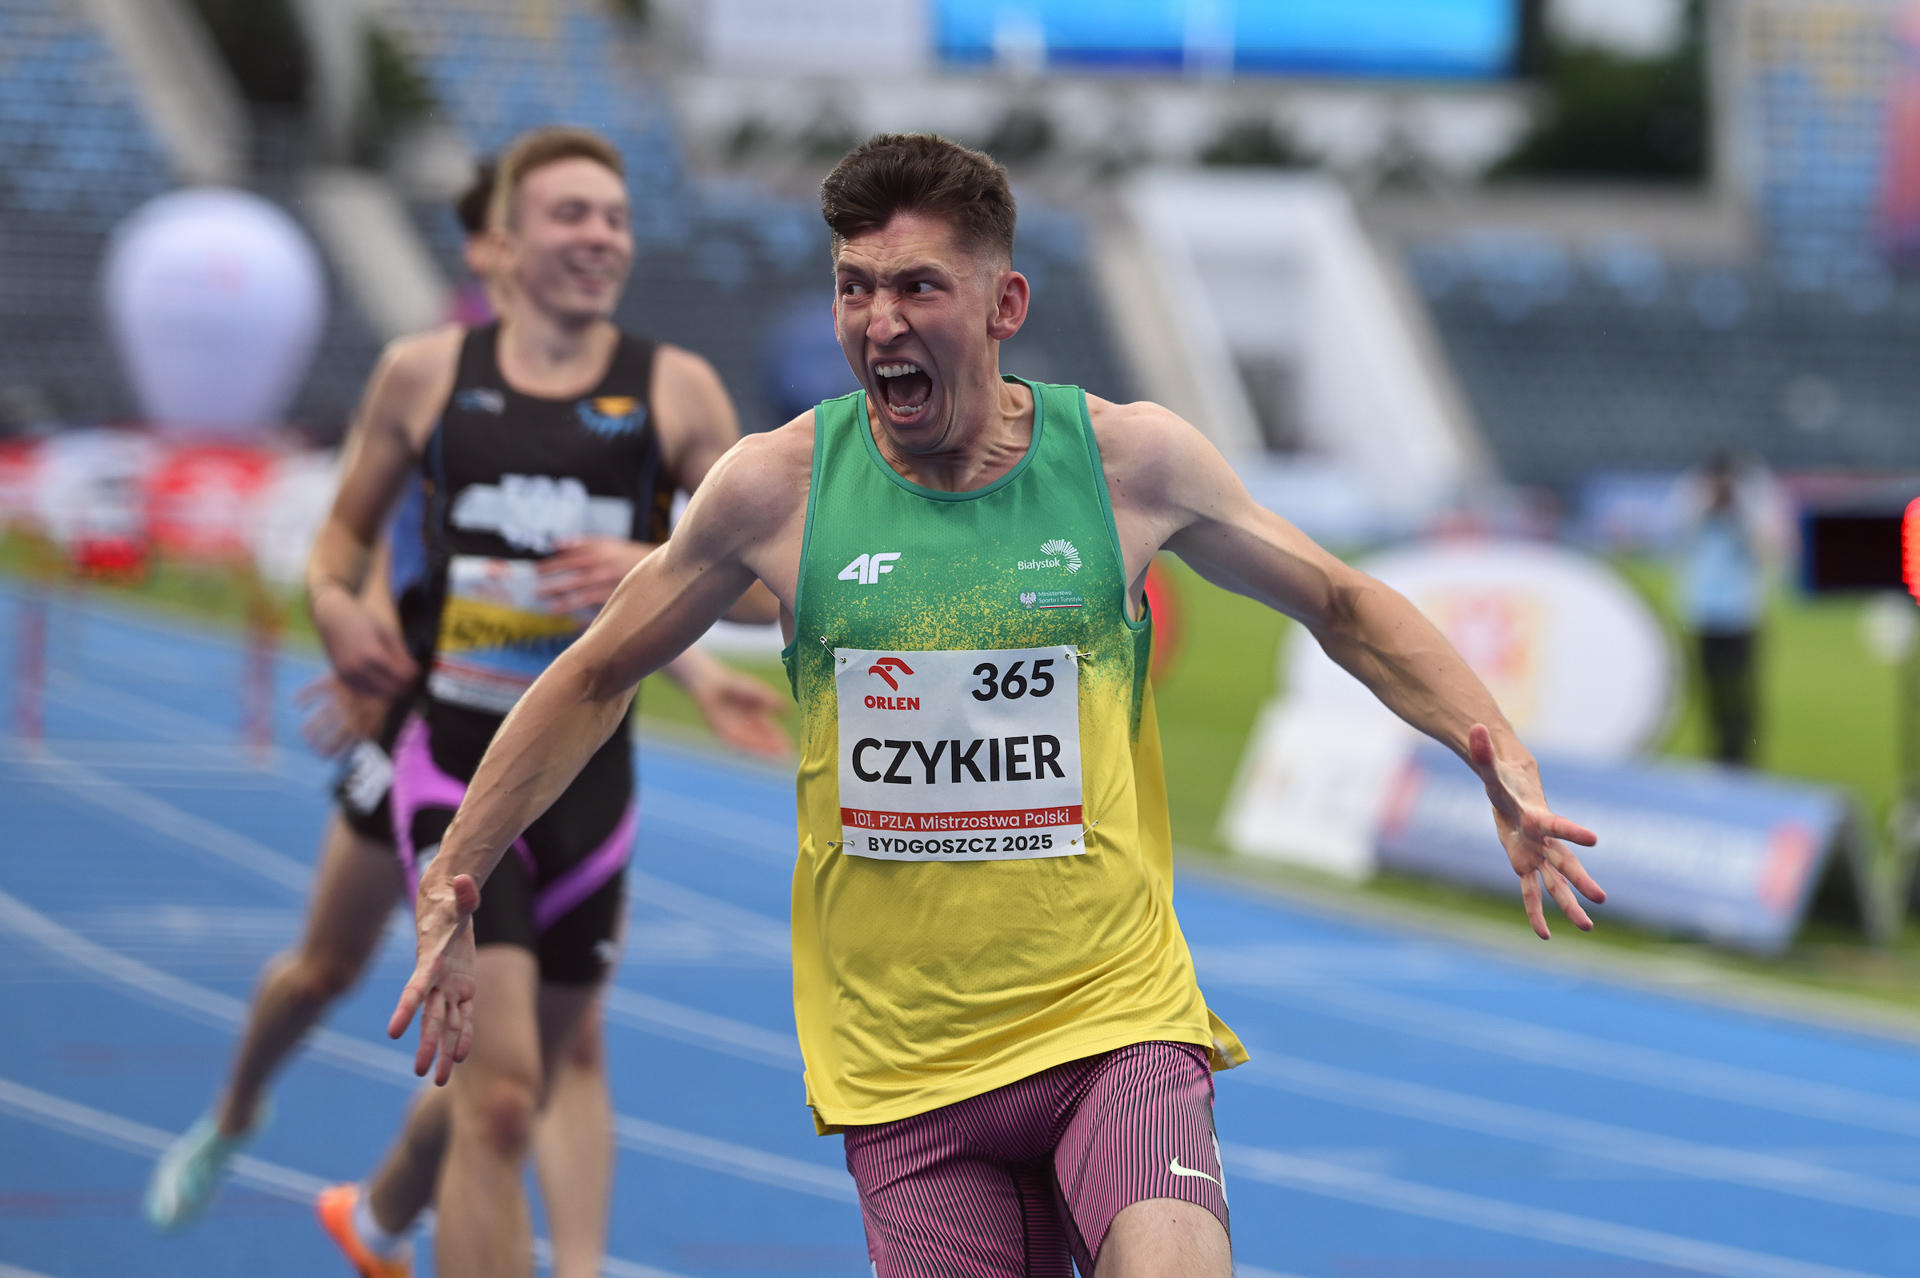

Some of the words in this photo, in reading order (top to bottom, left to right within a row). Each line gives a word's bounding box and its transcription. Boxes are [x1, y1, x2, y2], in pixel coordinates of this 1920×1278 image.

[838, 552, 902, 585] 4F
[1017, 557, 1061, 571] Białystok
[971, 659, 1055, 701] 365
[864, 695, 920, 710] ORLEN
[852, 734, 1065, 784] CZYKIER
[852, 812, 875, 828] 101.
[880, 815, 915, 829] PZLA
[920, 814, 1020, 829] Mistrzostwa
[1025, 809, 1069, 826] Polski
[868, 837, 997, 853] BYDGOSZCZ
[1002, 834, 1053, 851] 2025
